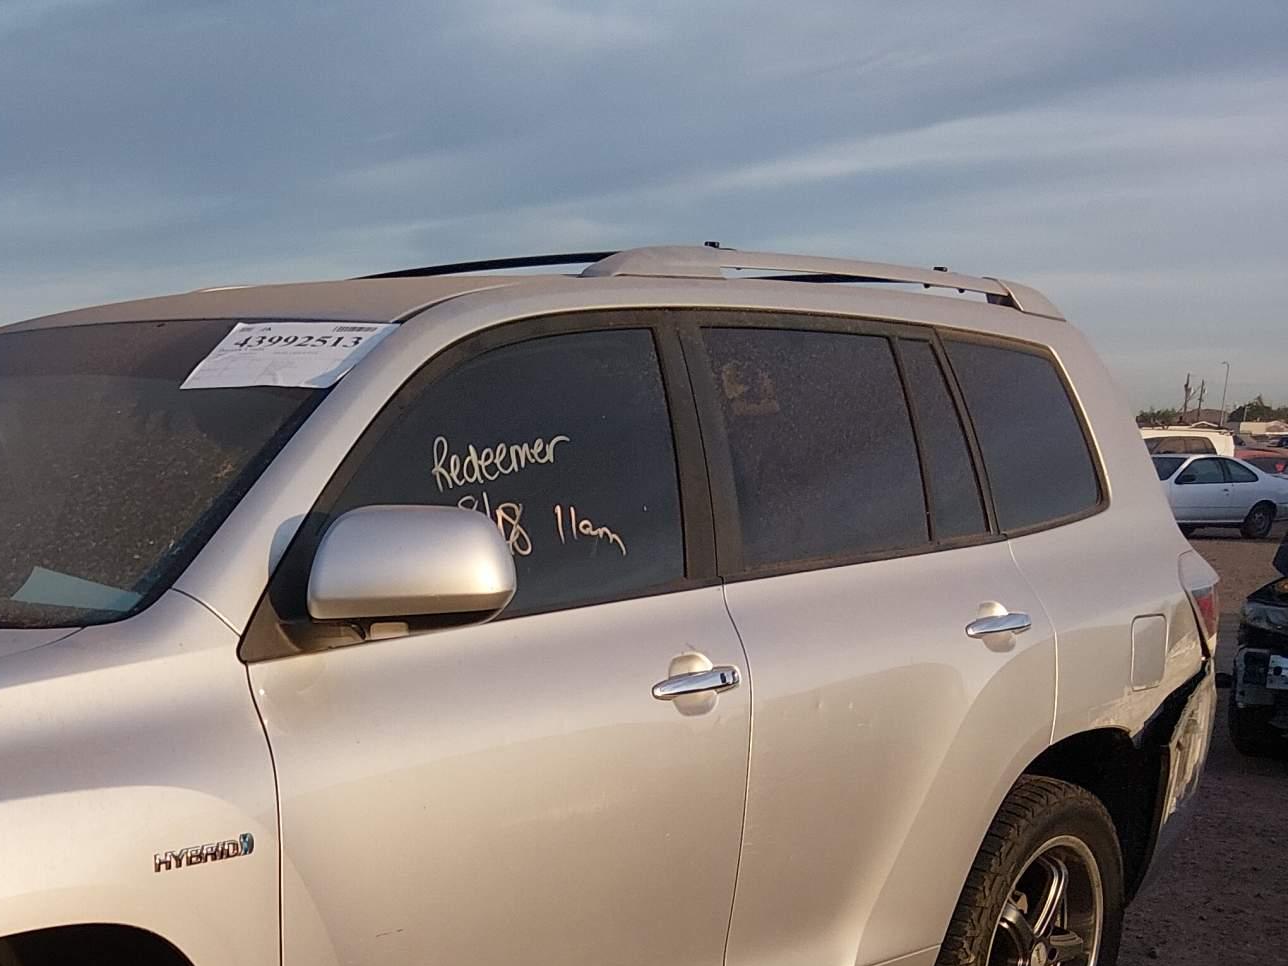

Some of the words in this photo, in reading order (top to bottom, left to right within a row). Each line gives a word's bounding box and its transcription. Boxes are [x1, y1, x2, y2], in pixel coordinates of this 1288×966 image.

[234, 335, 362, 348] 43992513
[432, 436, 570, 492] Redeemer
[554, 504, 627, 556] 11am
[154, 839, 242, 873] HYBRID
